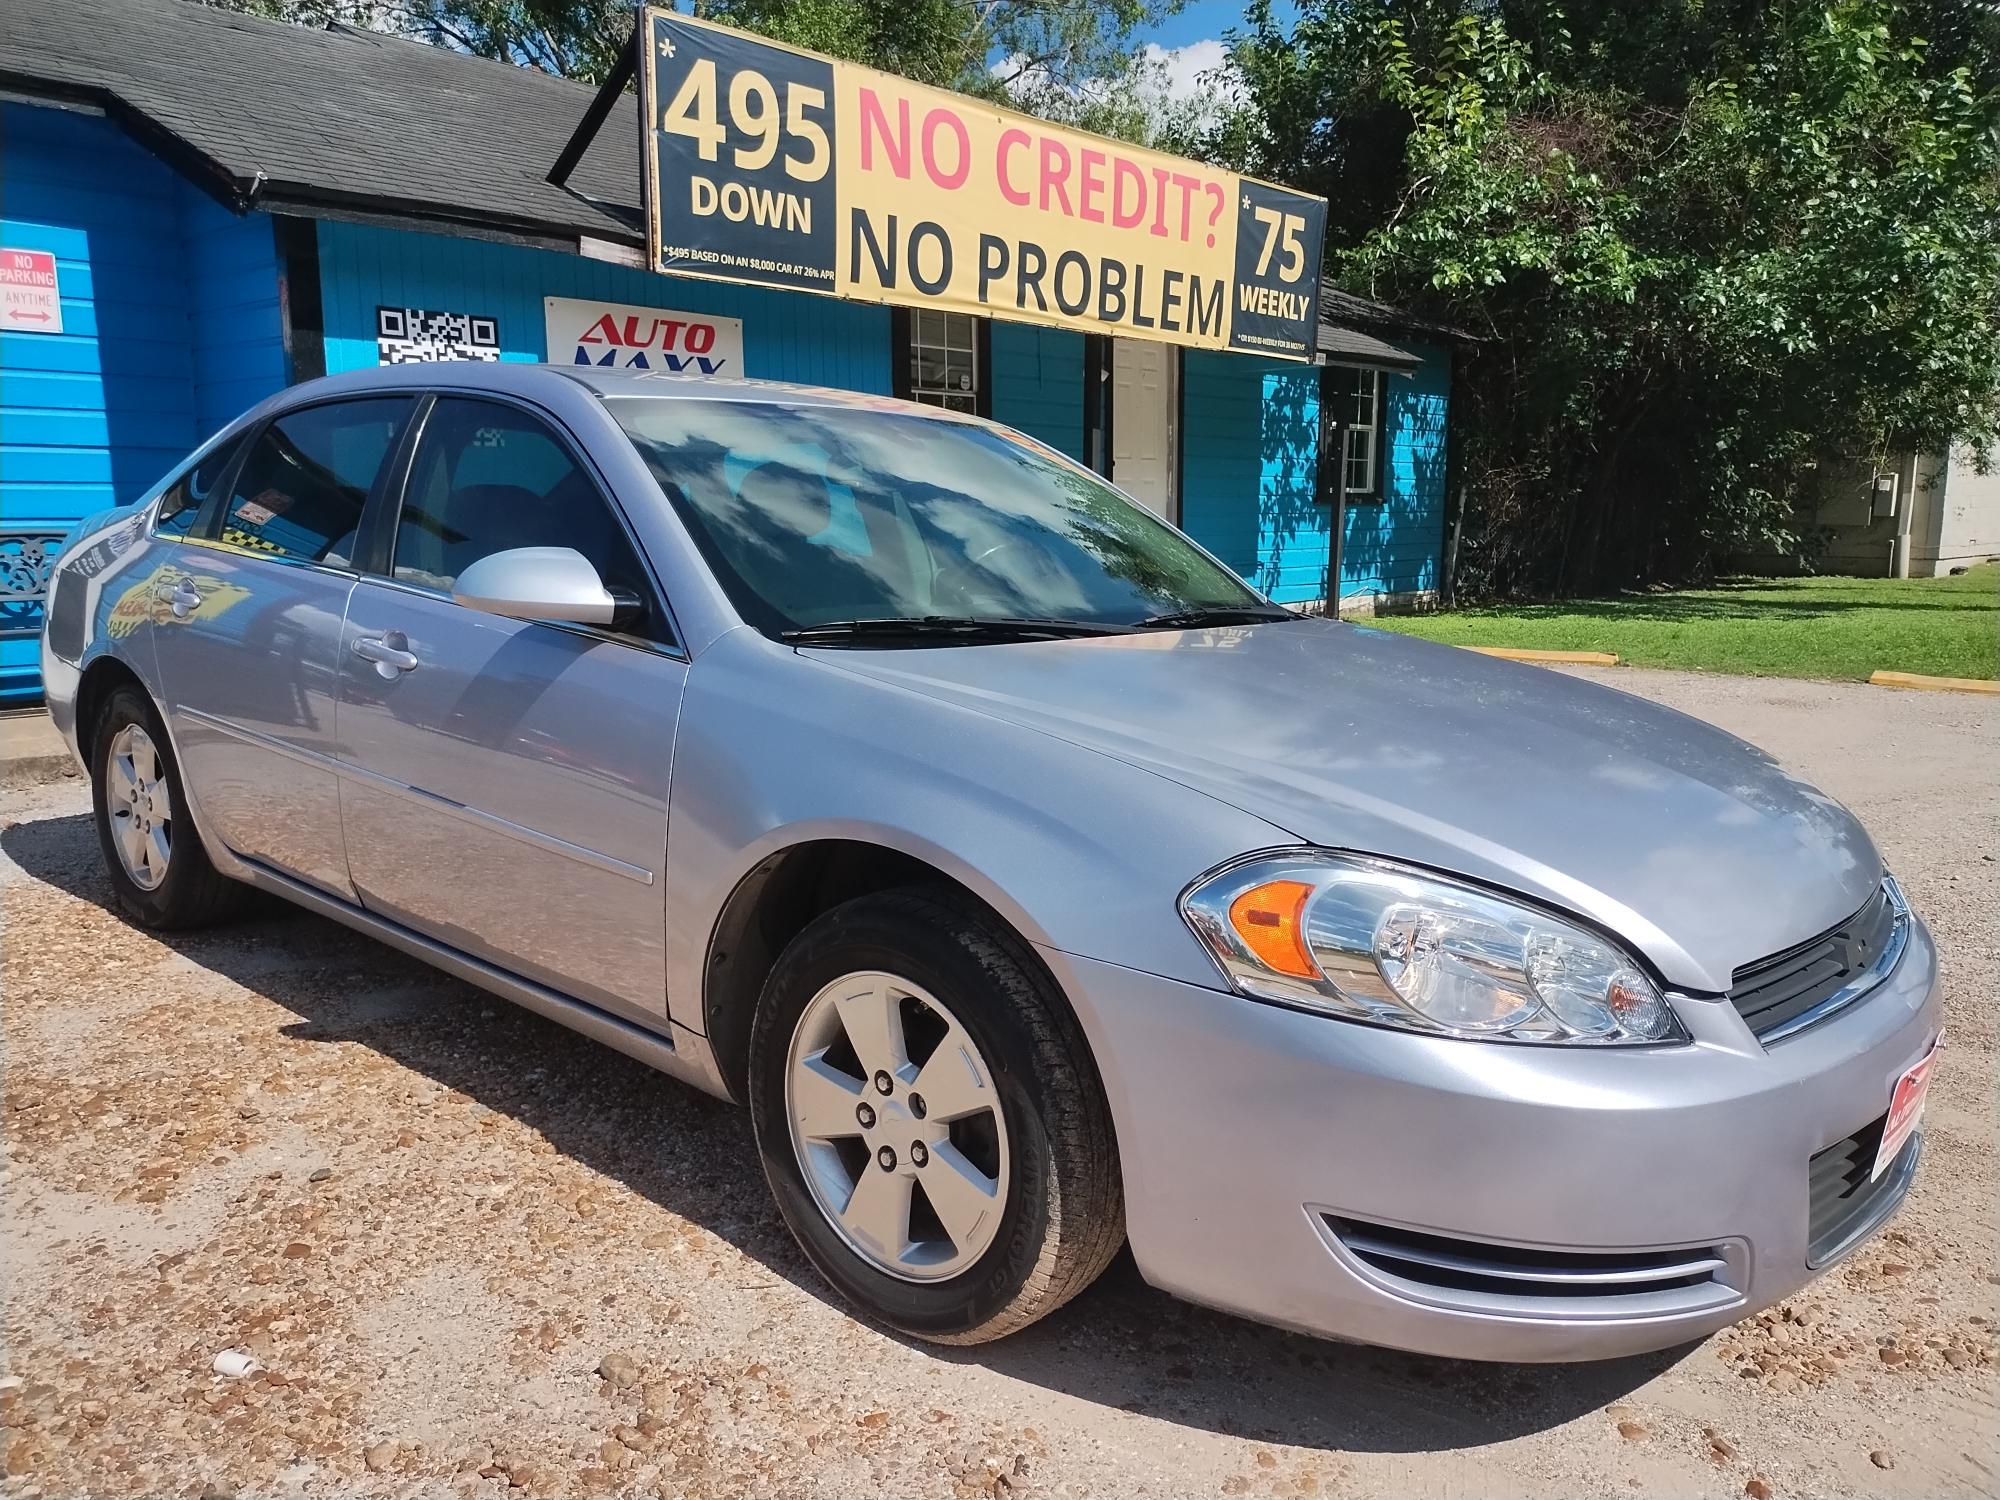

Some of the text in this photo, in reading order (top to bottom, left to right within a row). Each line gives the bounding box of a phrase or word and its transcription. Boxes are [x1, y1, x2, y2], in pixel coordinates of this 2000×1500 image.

[859, 87, 1225, 249] NO CREDIT?
[691, 175, 812, 235] DOWN
[0, 268, 54, 286] PARKING
[14, 254, 33, 269] NO
[691, 249, 719, 263] BASED
[720, 253, 735, 265] ON
[735, 256, 749, 268] AN
[749, 258, 776, 271] $8,000
[776, 262, 793, 274] CAR
[793, 265, 804, 275] AT
[804, 267, 820, 278] 26%
[820, 269, 835, 281] APR
[850, 207, 1226, 338] NO PROBLEM
[6, 290, 52, 307] ANYTIME
[1239, 283, 1310, 322] WEEKLY
[578, 313, 716, 354] AUTO
